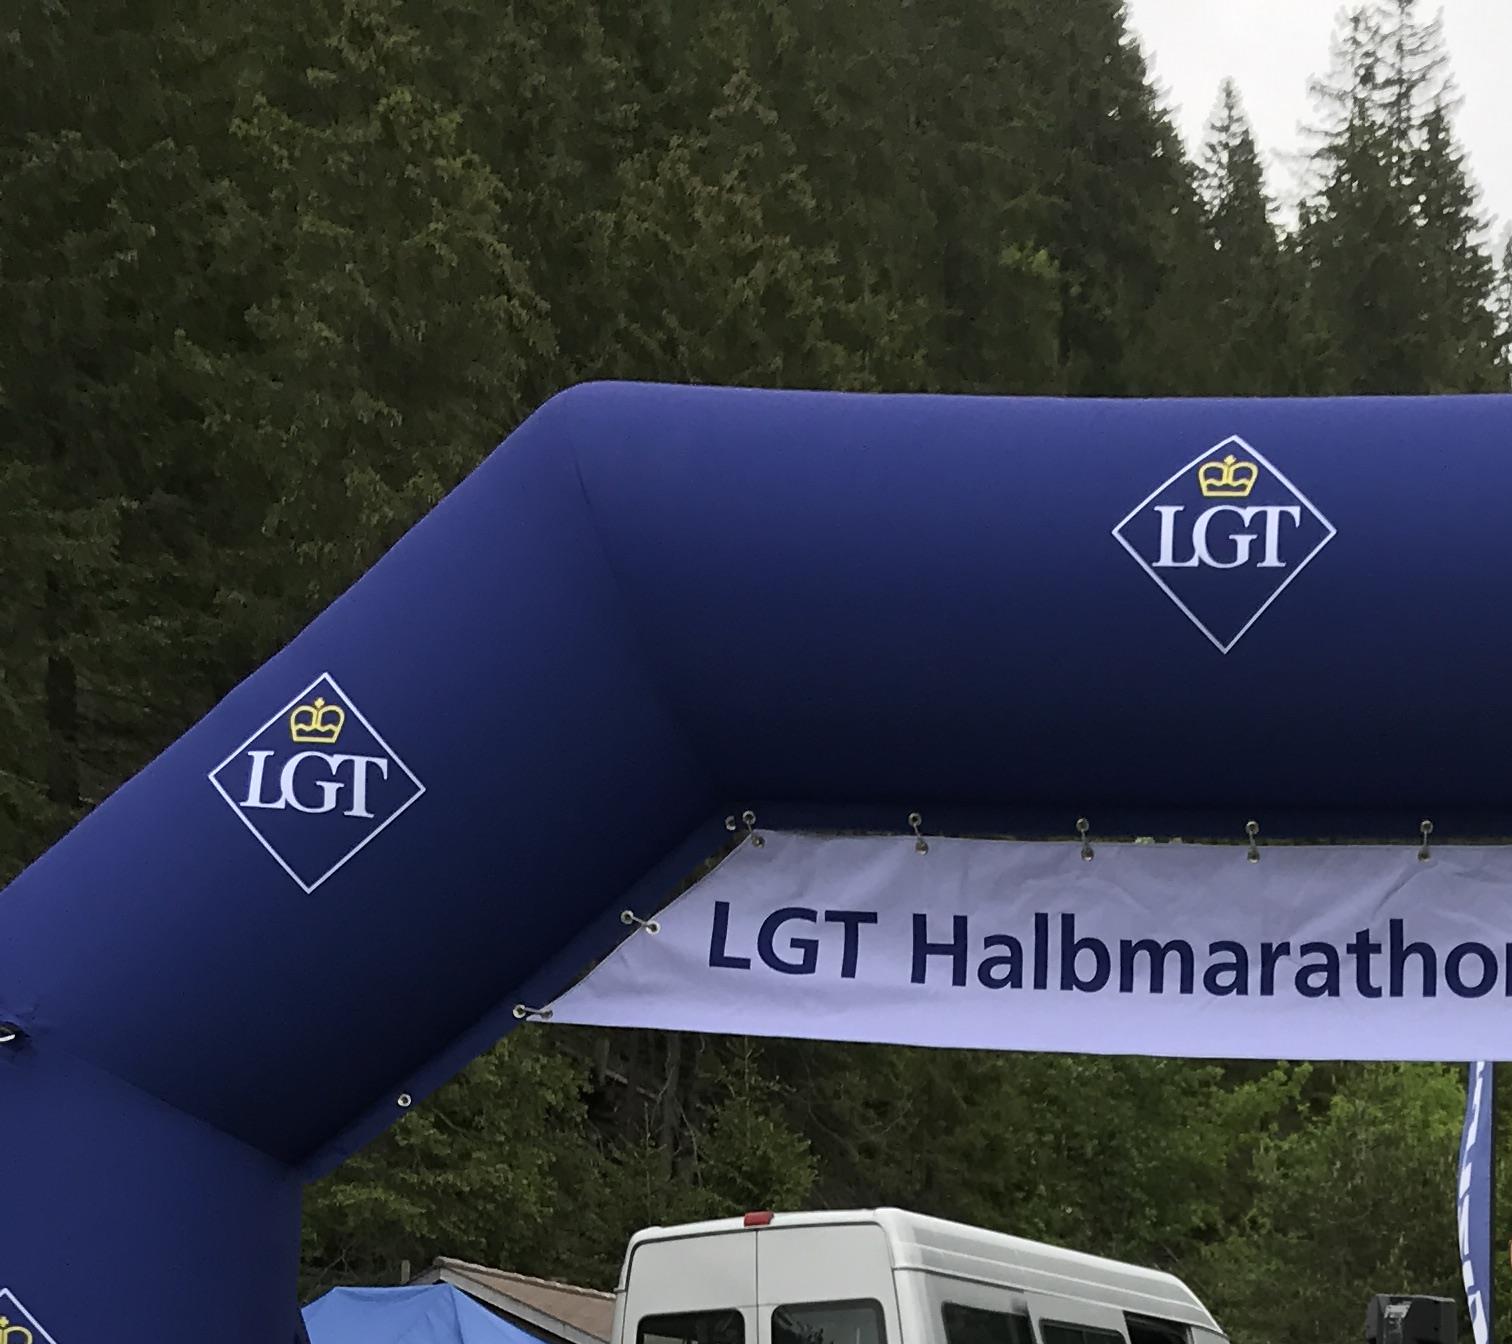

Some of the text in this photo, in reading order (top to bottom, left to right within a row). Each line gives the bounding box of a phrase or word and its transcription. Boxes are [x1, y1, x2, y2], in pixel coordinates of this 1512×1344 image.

[1152, 504, 1301, 569] LGT
[240, 750, 388, 818] LGT
[708, 901, 878, 978] LGT
